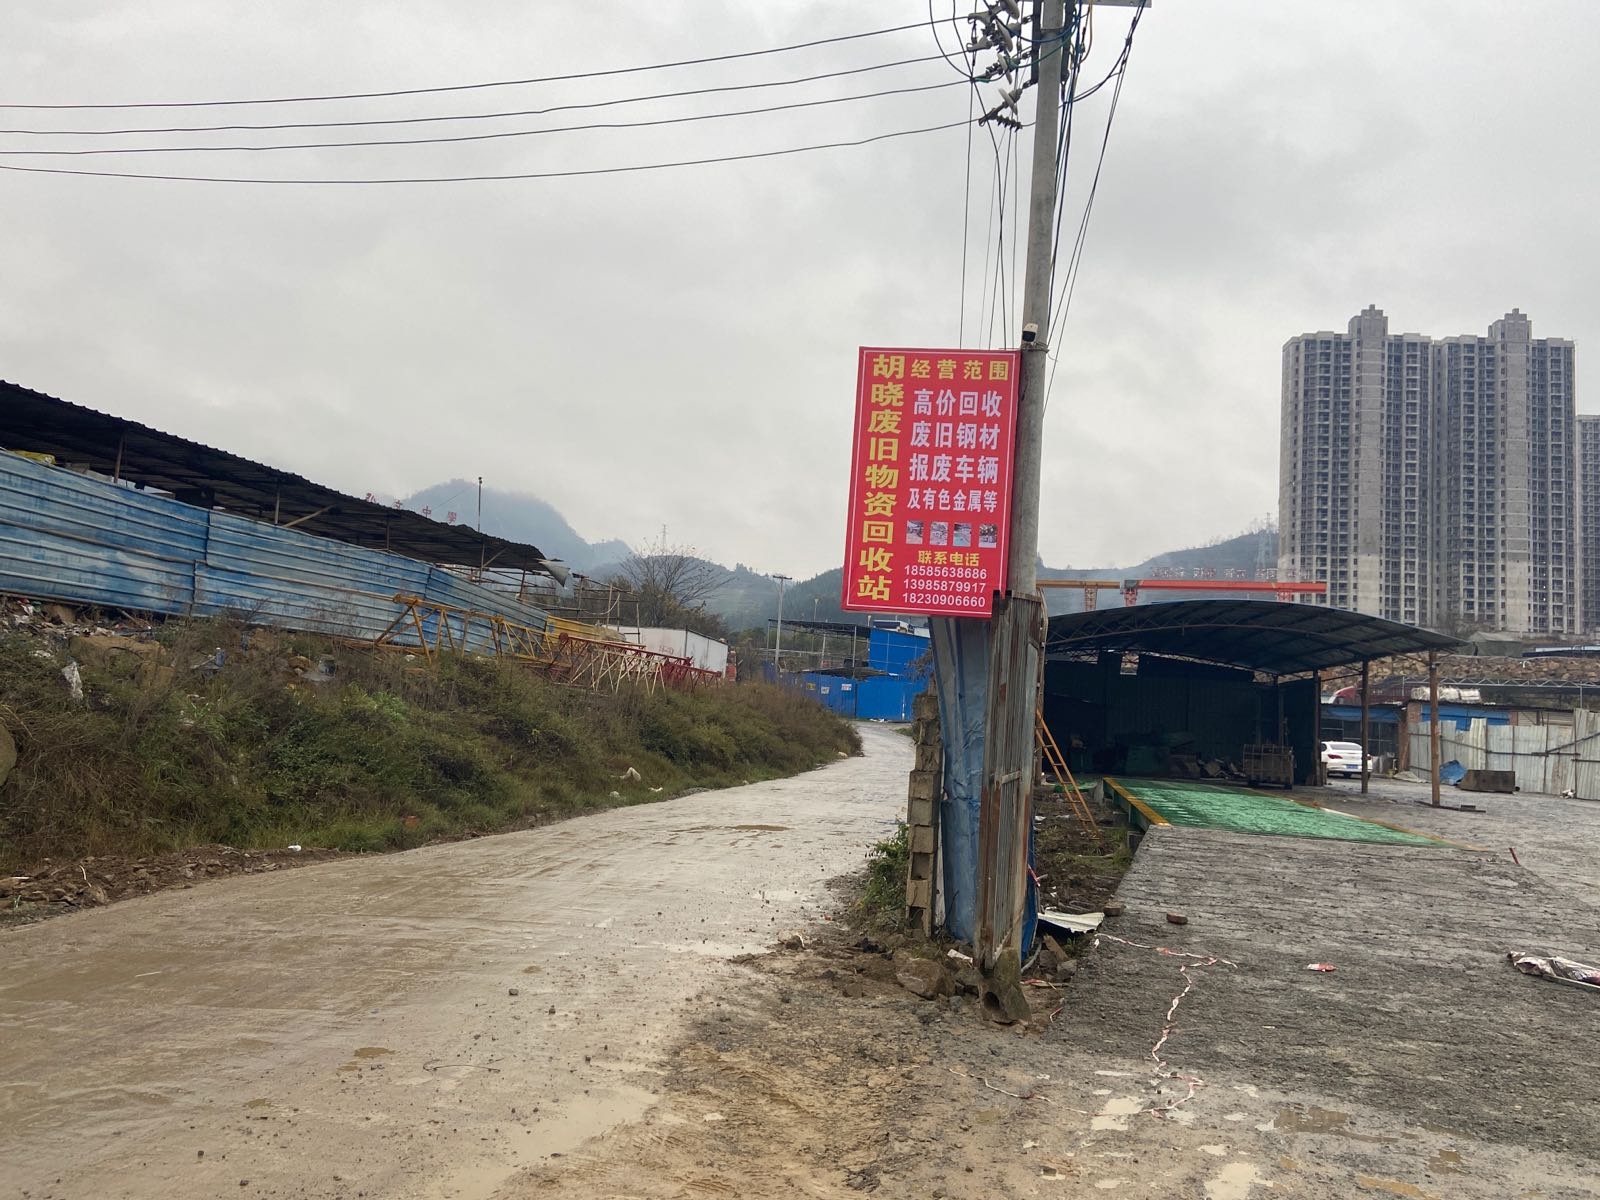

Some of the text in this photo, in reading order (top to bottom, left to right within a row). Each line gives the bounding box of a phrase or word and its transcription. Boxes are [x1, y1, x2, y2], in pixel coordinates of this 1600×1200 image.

[911, 359, 1009, 381] 经营范围
[913, 389, 1003, 417] 高价回收
[910, 421, 1000, 450] 废旧钢材
[857, 354, 906, 601] 胡晓废旧物资回收站
[909, 453, 999, 484] 报废车辆
[907, 487, 998, 513] 及有色金属等
[918, 550, 980, 567] 联系电话
[904, 565, 987, 579] 18585638686
[903, 579, 986, 593] 13985879917
[902, 592, 986, 608] 18230906660
